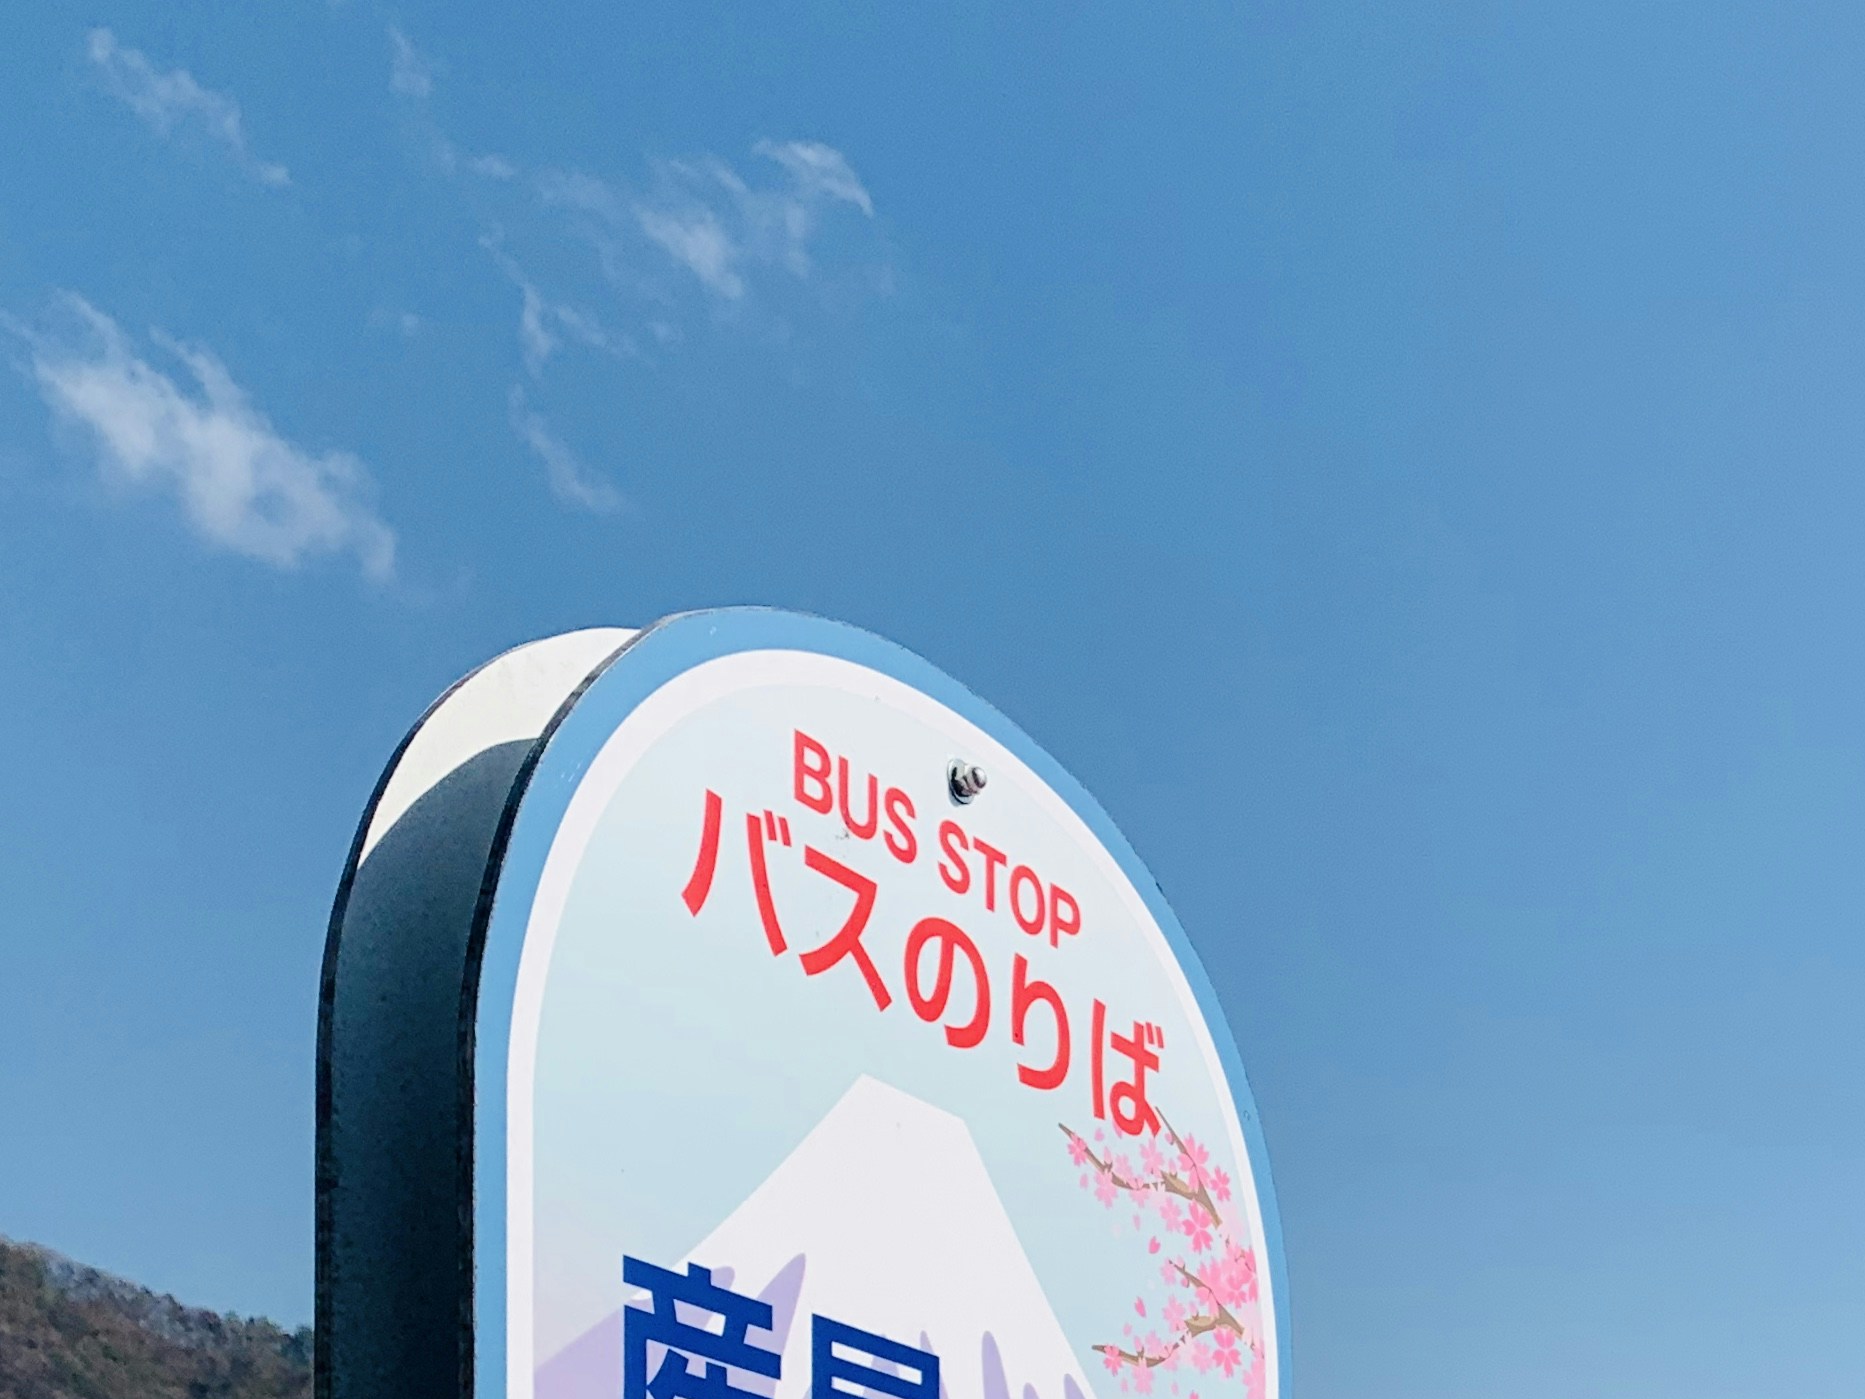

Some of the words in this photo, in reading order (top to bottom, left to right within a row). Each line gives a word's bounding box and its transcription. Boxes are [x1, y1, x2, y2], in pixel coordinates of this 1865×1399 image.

[681, 787, 1166, 1137] バスのりば
[792, 728, 918, 865] BUS
[938, 819, 1082, 950] STOP
